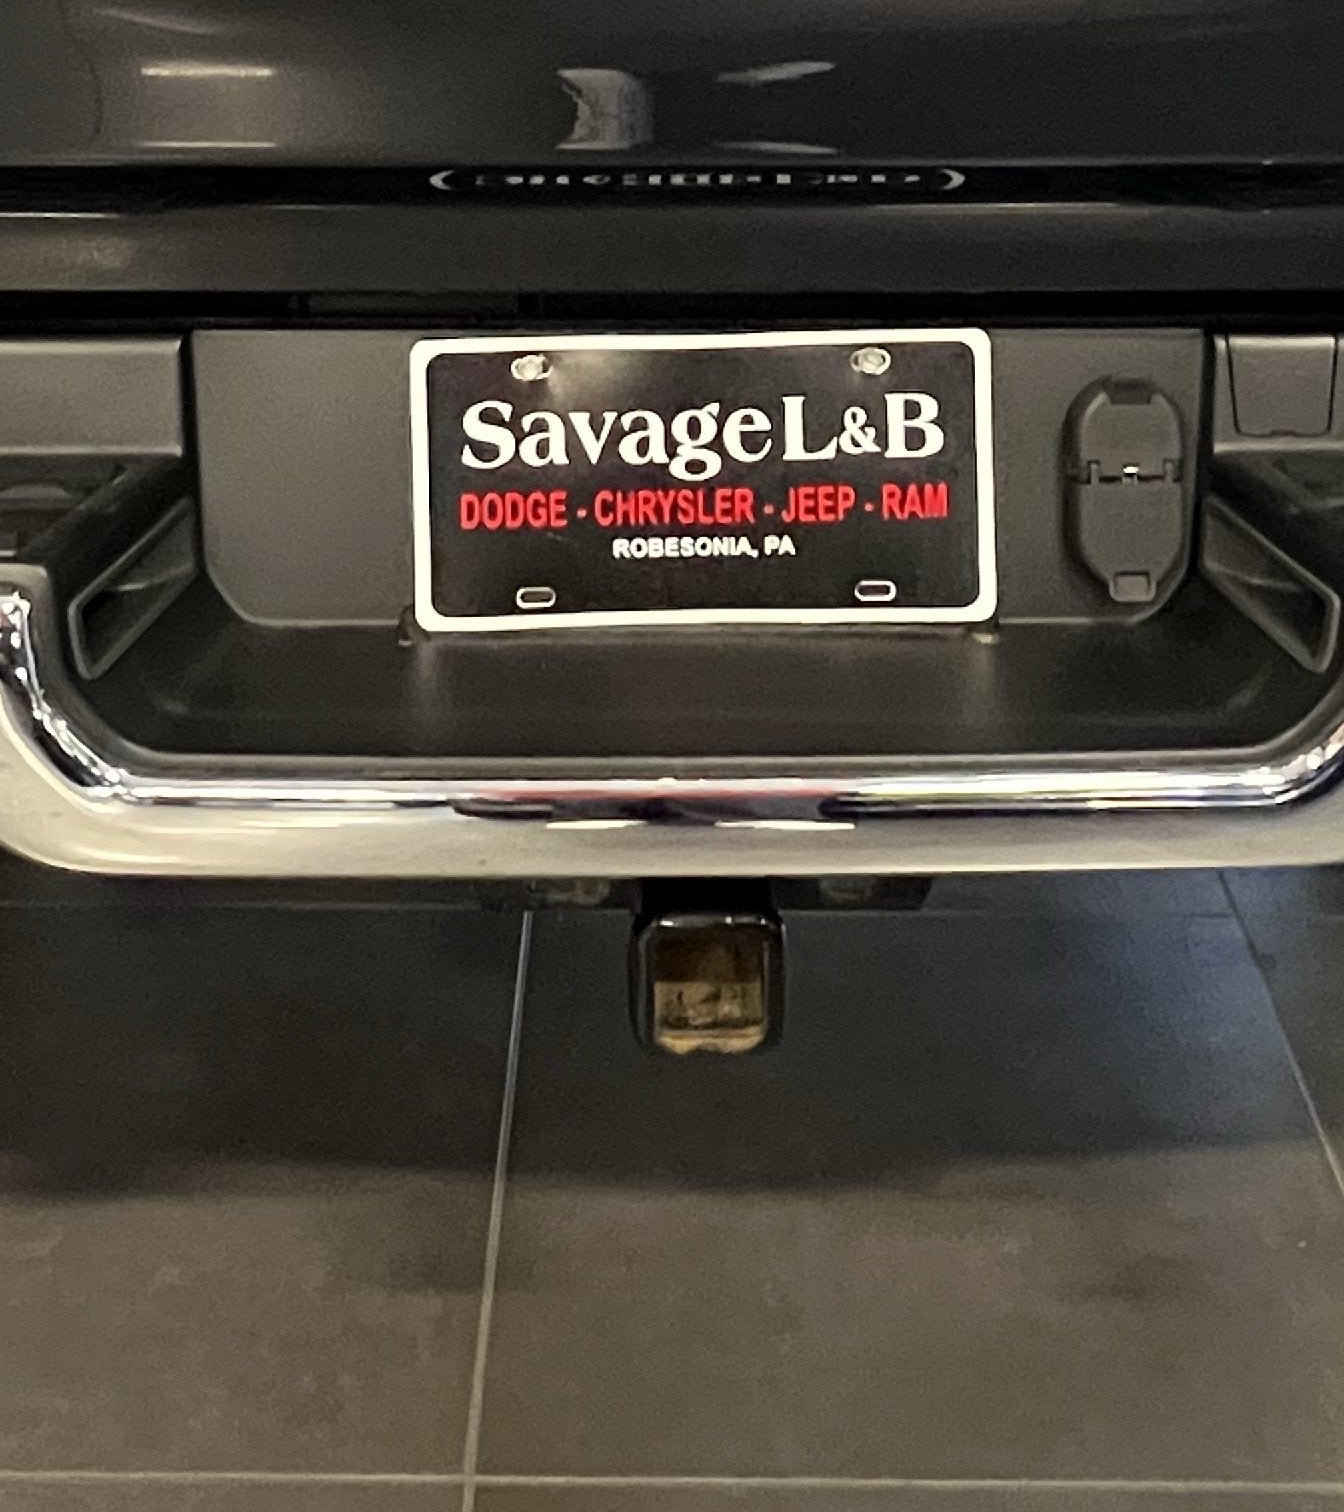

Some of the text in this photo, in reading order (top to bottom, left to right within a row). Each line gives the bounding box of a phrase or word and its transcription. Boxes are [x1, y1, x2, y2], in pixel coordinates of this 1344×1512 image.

[460, 491, 567, 529] DODGE
[594, 488, 754, 526] CHRYSLER
[781, 485, 855, 523] JEEP
[881, 483, 949, 519] RAM
[612, 535, 796, 559] ROBESONIA, PA
